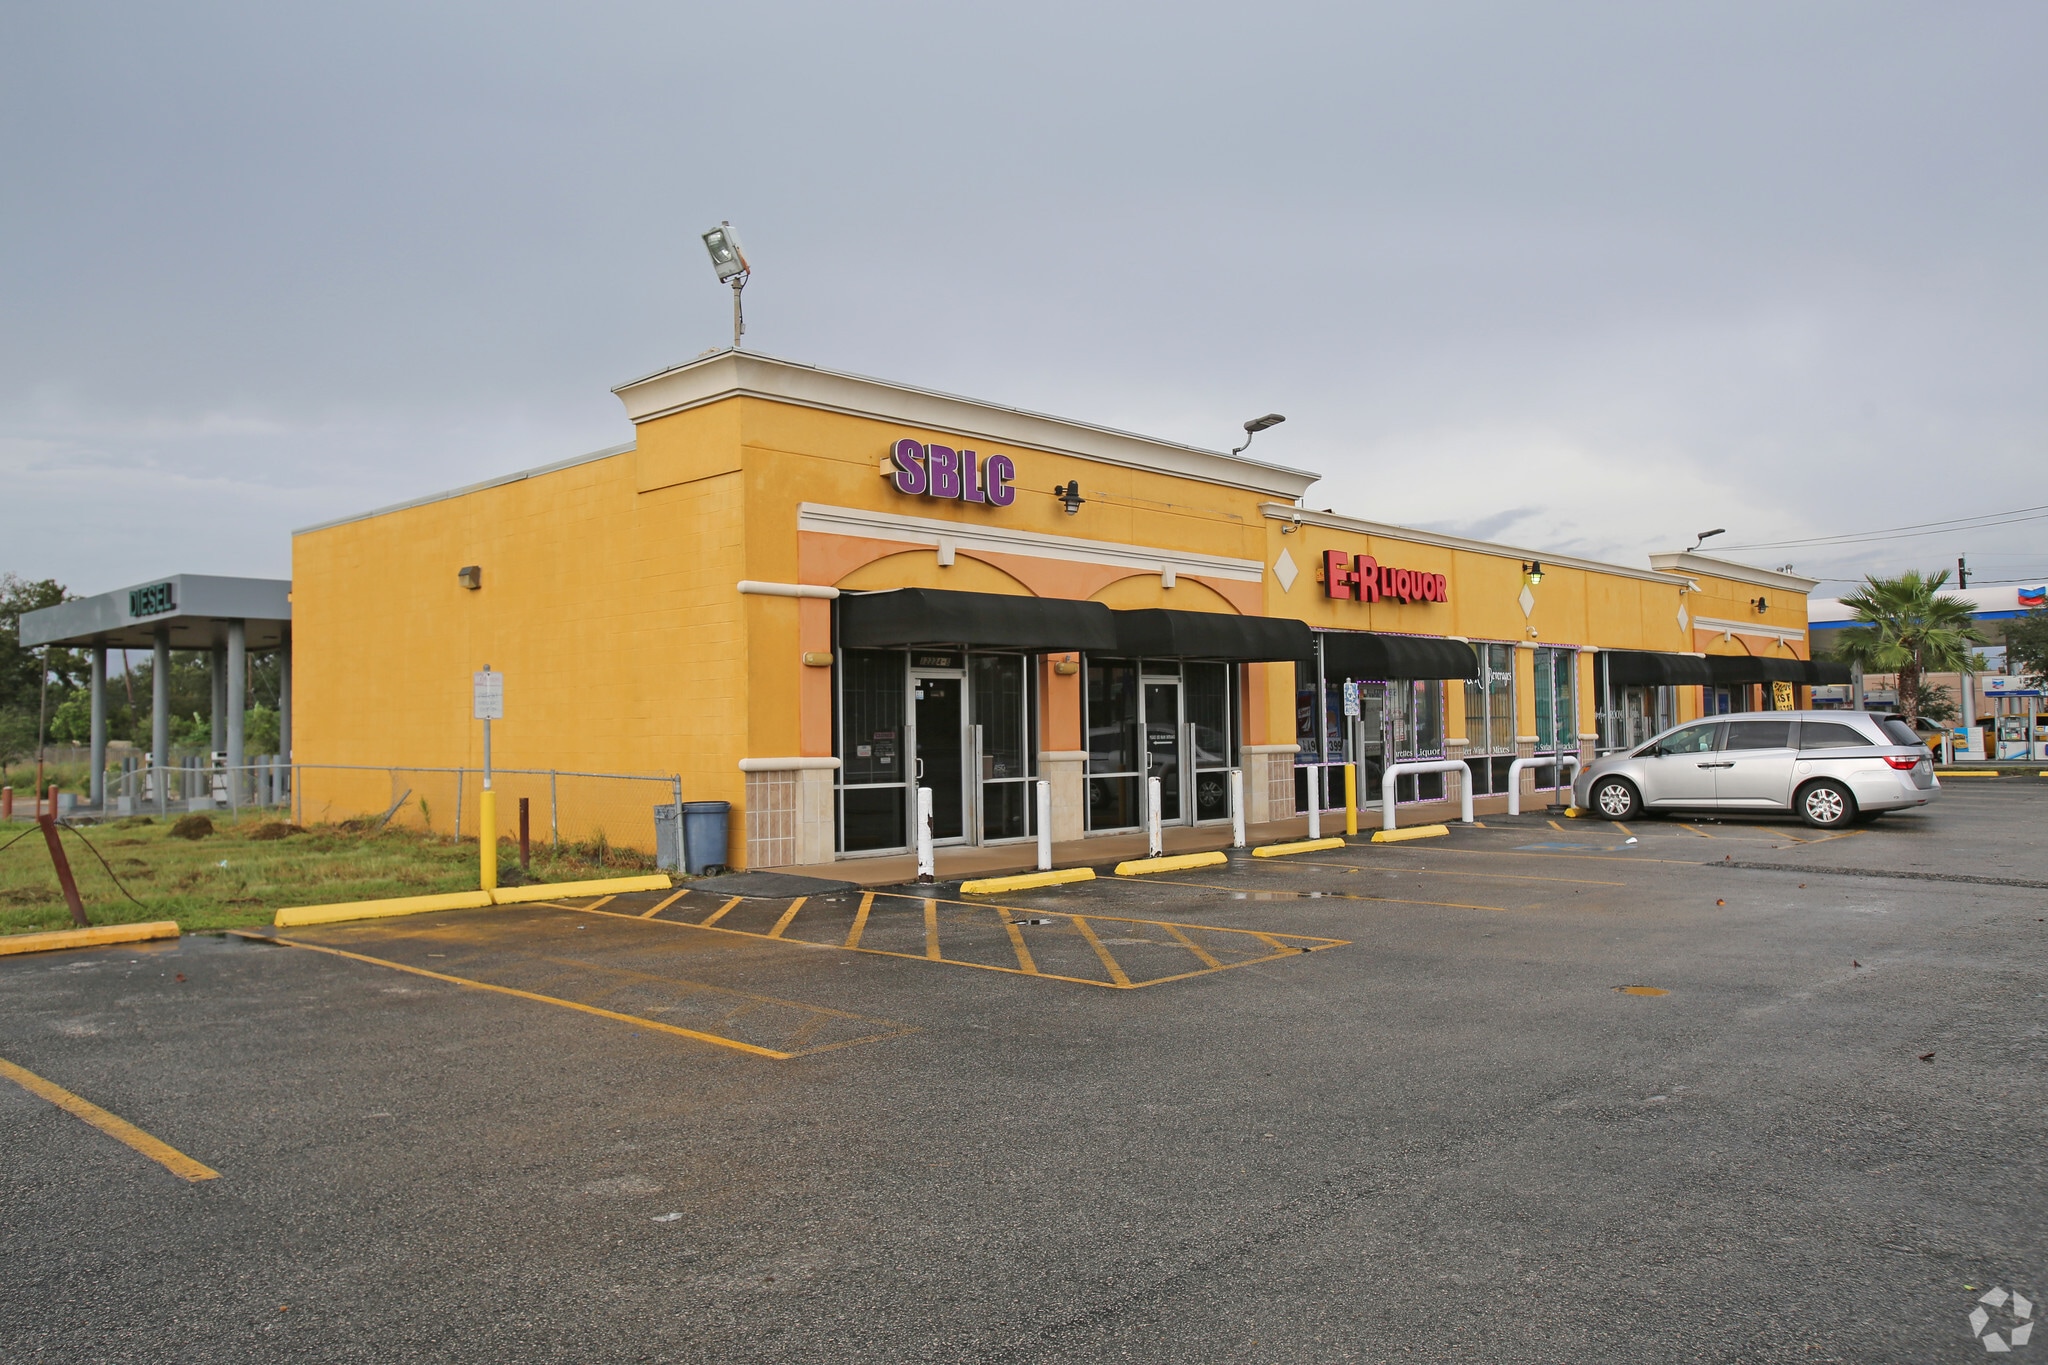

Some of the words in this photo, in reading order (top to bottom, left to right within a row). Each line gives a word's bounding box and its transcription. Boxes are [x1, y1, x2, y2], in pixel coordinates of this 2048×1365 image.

[890, 438, 1016, 507] SBLC
[129, 583, 173, 617] DIESEL
[1379, 566, 1448, 604] LIQUOR
